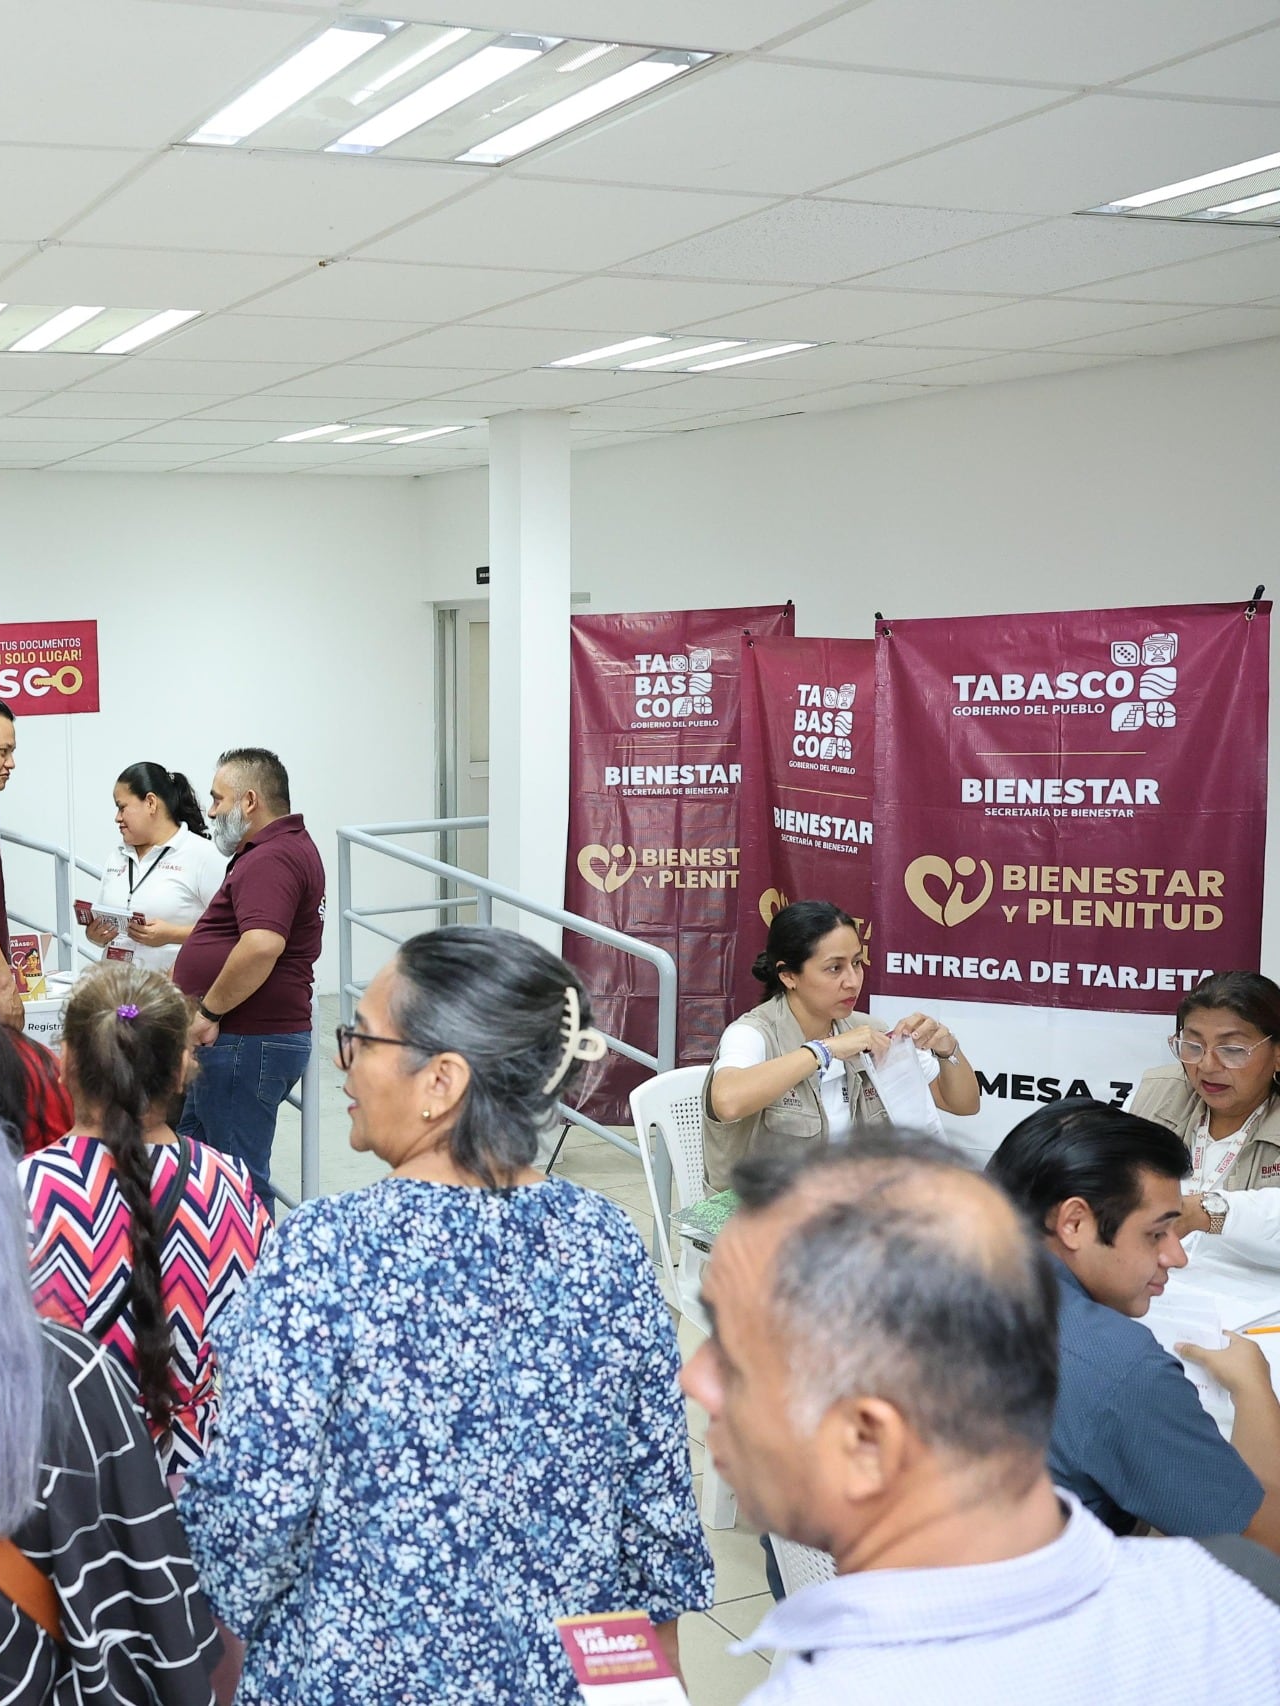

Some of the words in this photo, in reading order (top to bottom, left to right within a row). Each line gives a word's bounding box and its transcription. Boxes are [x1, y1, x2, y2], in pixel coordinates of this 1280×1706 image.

[0, 641, 17, 651] TUS
[20, 638, 81, 650] DOCUMENTOS
[5, 652, 36, 664] SOLO
[40, 649, 82, 663] LUGAR!
[635, 654, 669, 673] TA
[635, 675, 686, 696] BAS
[797, 684, 821, 707] TA
[952, 670, 1134, 702] TABASCO
[635, 698, 670, 718] CO
[952, 705, 1021, 716] GOBIERNO
[1024, 705, 1049, 715] DEL
[1052, 703, 1105, 715] PUEBLO
[793, 709, 834, 735] BAS
[793, 735, 821, 758] CO
[604, 764, 741, 786] BIENESTAR
[789, 760, 819, 771] GOBIERNO
[820, 763, 830, 772] DEL
[831, 765, 856, 775] PUEBLO
[622, 787, 670, 796] SECRETARÍA
[673, 787, 683, 795] DE
[685, 787, 729, 795] BIENESTAR
[961, 778, 1160, 805] BIENESTAR
[984, 807, 1050, 817] SECRETARÍA
[1053, 808, 1068, 817] DE
[1071, 808, 1134, 818] BIENESTAR
[773, 806, 874, 845] BIENESTAR
[781, 833, 813, 847] SECRETARÍA
[815, 840, 822, 848] DE
[822, 841, 858, 855] BIENESTAR
[642, 848, 740, 866] BIENEST
[642, 875, 653, 888] Y
[659, 870, 740, 889] PLENIT
[1002, 864, 1225, 897] BIENESTAR
[1001, 905, 1019, 923] Y
[1027, 898, 1224, 931] PLENITUD
[886, 952, 1023, 982] ENTREGA
[1029, 960, 1070, 984] DE
[974, 1070, 1094, 1104] MESA
